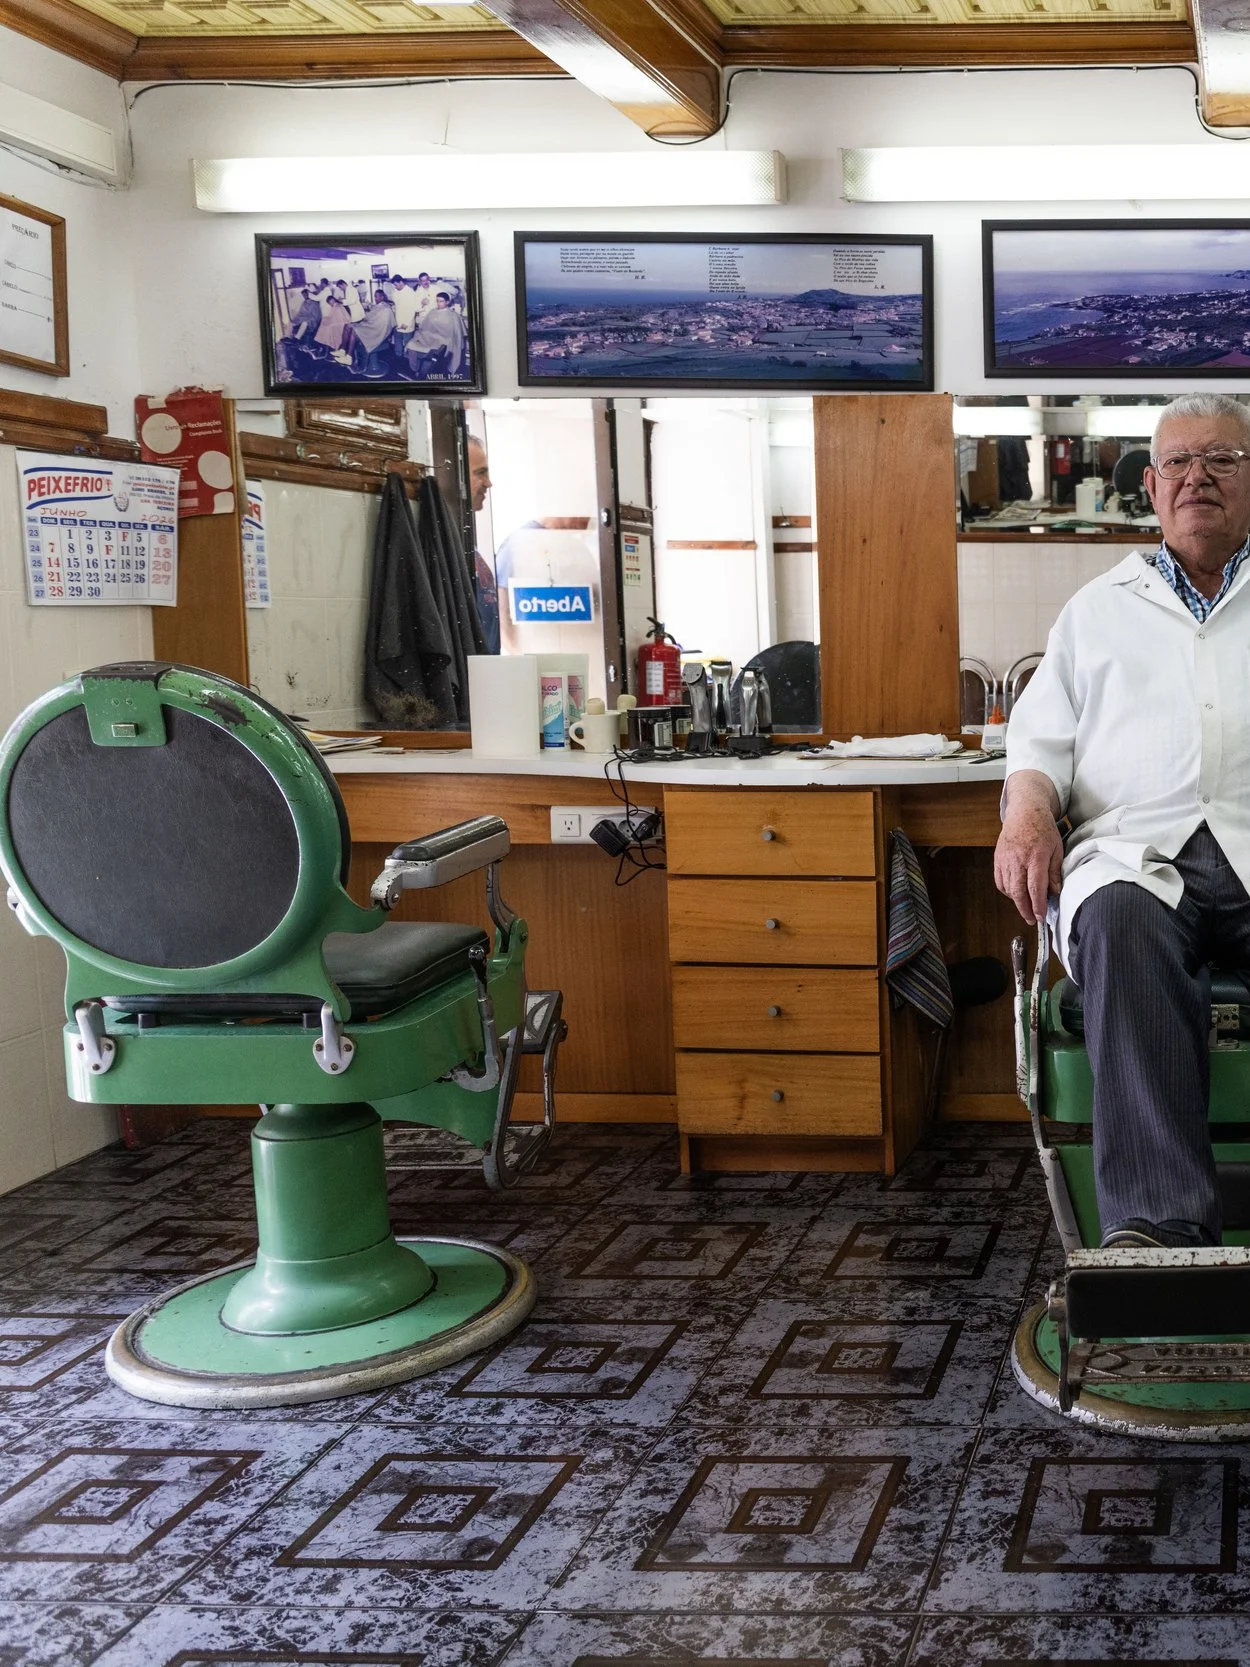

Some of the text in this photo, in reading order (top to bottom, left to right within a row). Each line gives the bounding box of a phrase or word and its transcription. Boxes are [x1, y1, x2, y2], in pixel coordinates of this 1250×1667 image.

[187, 420, 222, 428] Reclamações
[27, 475, 103, 501] PEIXEFRIO
[40, 507, 88, 518] JUNHO
[141, 514, 175, 525] 2026
[67, 529, 73, 539] 1
[85, 530, 93, 540] 2
[104, 531, 112, 541] 3
[121, 531, 129, 542] F
[136, 533, 142, 542] 5
[158, 534, 168, 545] 6
[48, 542, 55, 553] 7
[68, 543, 75, 554] 8
[86, 544, 94, 554] 9
[104, 544, 114, 555] F
[121, 545, 130, 556] 11
[134, 546, 145, 556] 12
[153, 547, 172, 558] 13
[32, 557, 172, 572] 25 14 15 16 17 18 19 20
[47, 571, 62, 582] 21
[66, 572, 81, 582] 22
[86, 572, 100, 583] 23
[104, 573, 117, 583] 24
[120, 572, 131, 583] 25
[134, 573, 146, 584] 26
[152, 573, 172, 585] 27
[49, 586, 64, 597] 28
[68, 586, 82, 597] 29
[87, 586, 101, 597] 30
